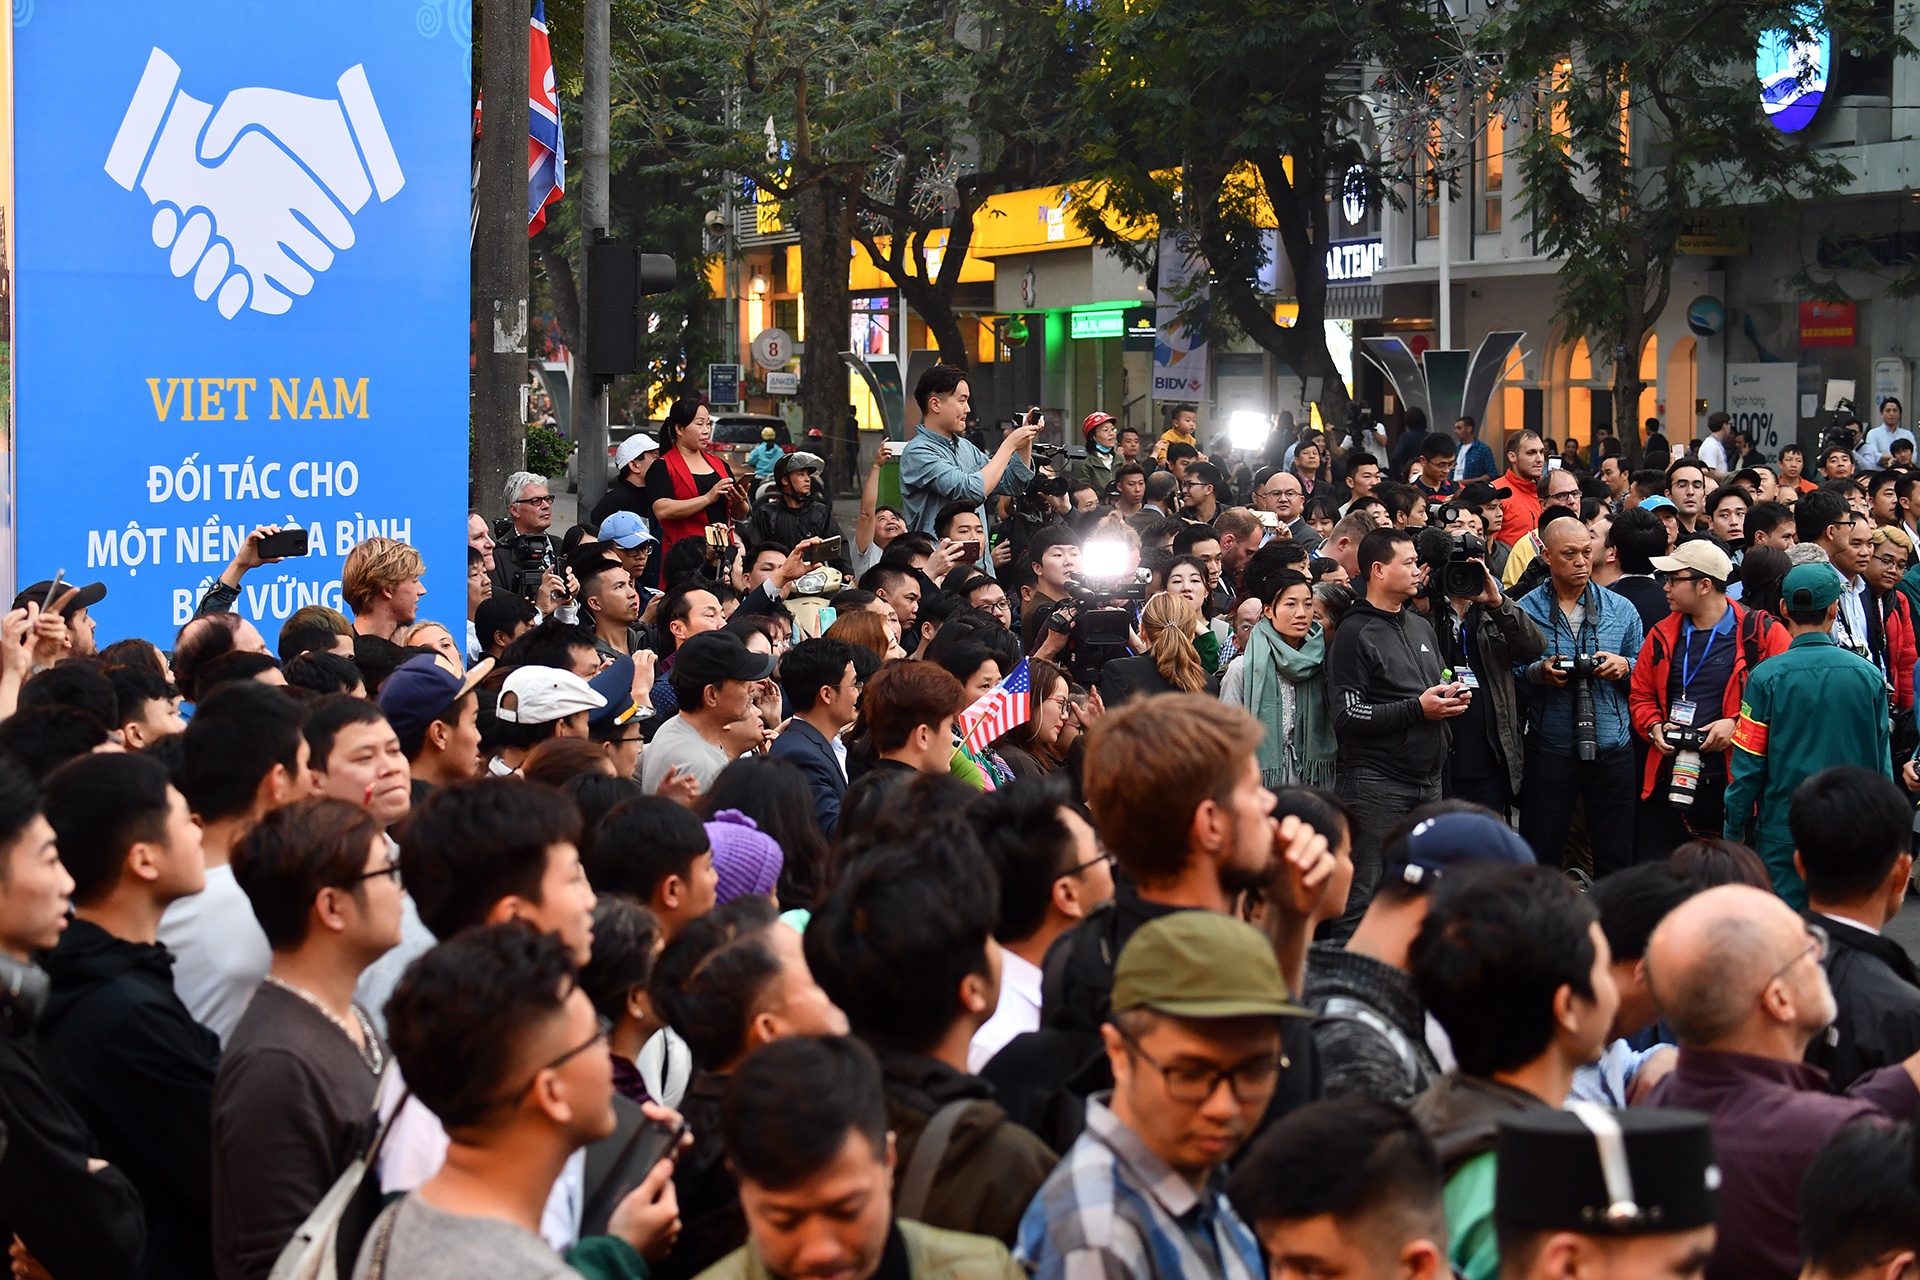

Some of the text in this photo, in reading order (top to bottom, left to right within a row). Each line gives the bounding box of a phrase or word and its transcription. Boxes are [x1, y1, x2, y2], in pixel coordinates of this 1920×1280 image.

[769, 342, 779, 357] 8
[146, 377, 370, 422] VIET NAM
[1155, 377, 1188, 390] BIDV
[146, 452, 359, 503] ĐỐI TÁC CHO
[87, 520, 167, 577] MỘT
[246, 575, 344, 621] VỮNG
